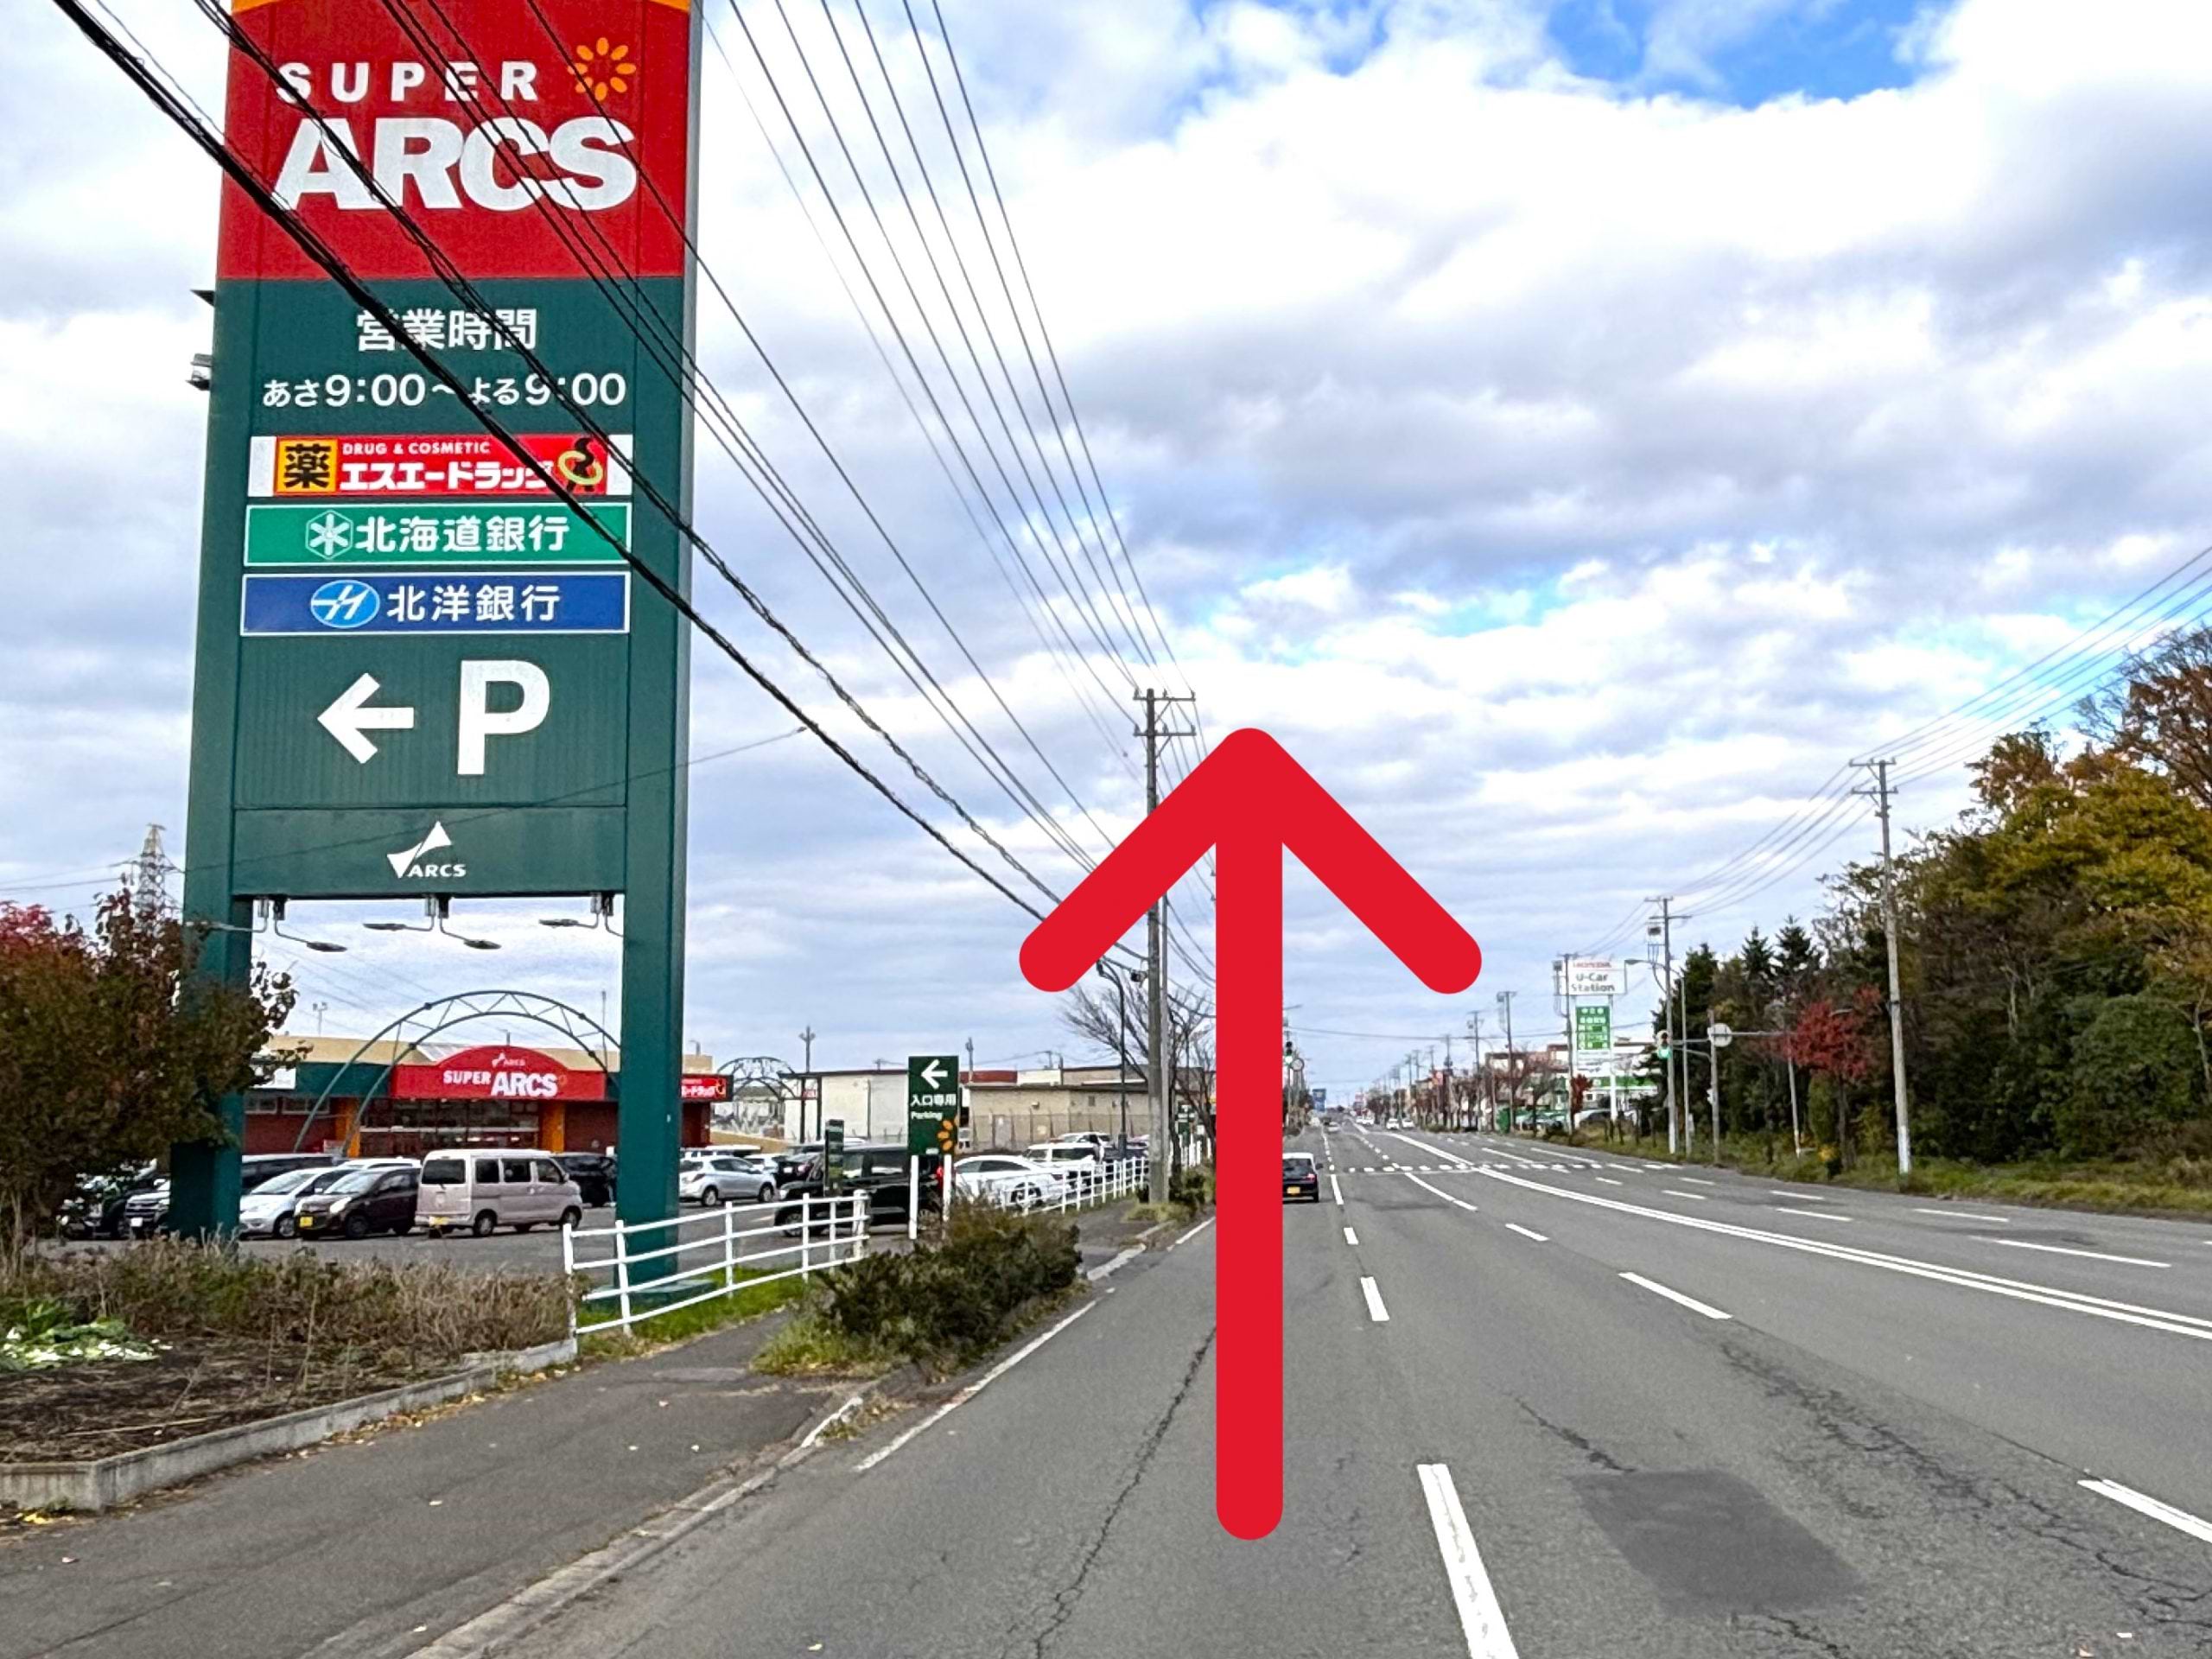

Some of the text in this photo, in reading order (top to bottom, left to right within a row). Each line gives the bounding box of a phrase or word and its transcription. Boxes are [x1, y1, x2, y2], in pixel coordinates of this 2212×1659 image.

[275, 60, 538, 103] SUPER
[270, 116, 637, 213] ARCS
[356, 308, 537, 352] 営業時間
[283, 443, 332, 489] 薬
[342, 441, 490, 455] DRUG & COSMETIC
[355, 515, 570, 553] 北海道銀行
[386, 584, 561, 622] 北洋銀行
[457, 659, 551, 775] P
[407, 864, 467, 878] ARCS
[1571, 983, 1615, 993] Station
[442, 1071, 558, 1097] SUPER ARCS
